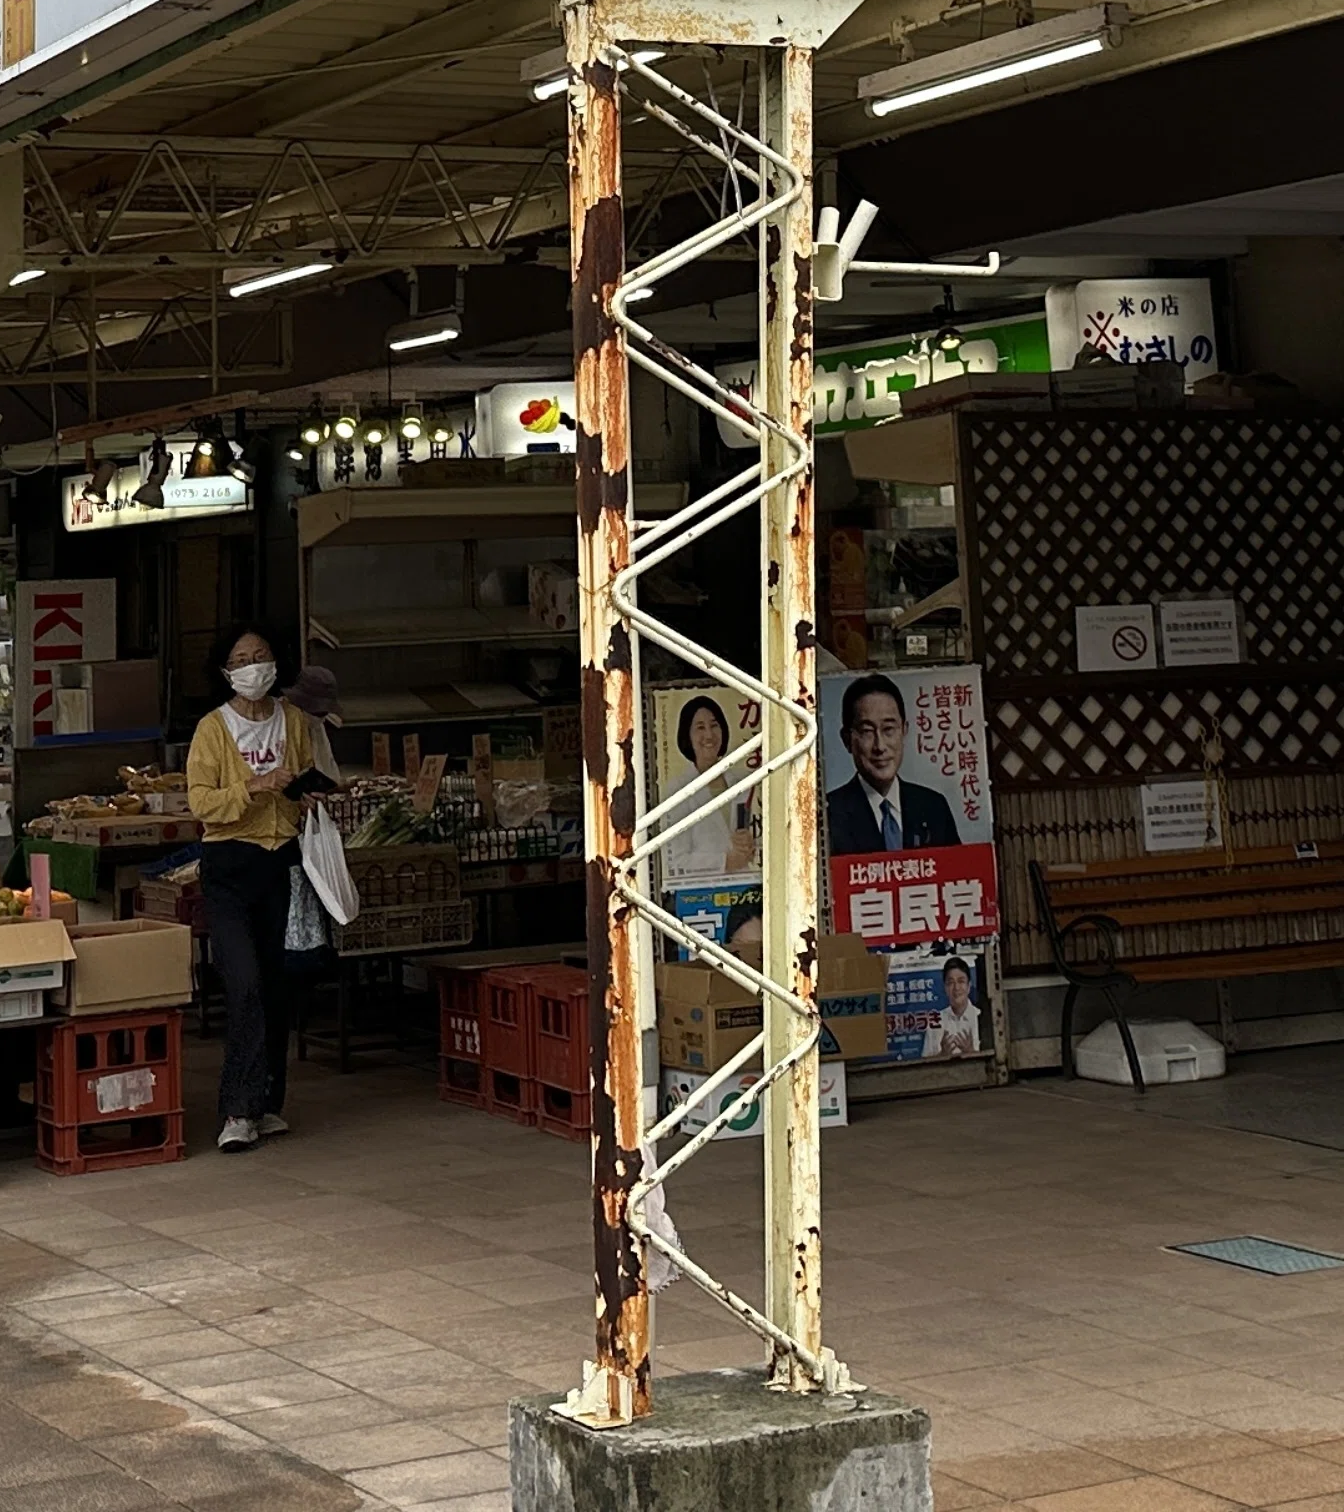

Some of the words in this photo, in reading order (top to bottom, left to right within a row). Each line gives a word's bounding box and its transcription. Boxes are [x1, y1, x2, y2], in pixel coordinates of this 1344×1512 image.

[1118, 296, 1180, 316] 米の店
[915, 686, 937, 763] ともに。
[933, 686, 955, 776] 皆さんと
[953, 685, 981, 821] 新しい時代を
[849, 858, 936, 885] 比例代表は
[849, 879, 986, 938] 自民党
